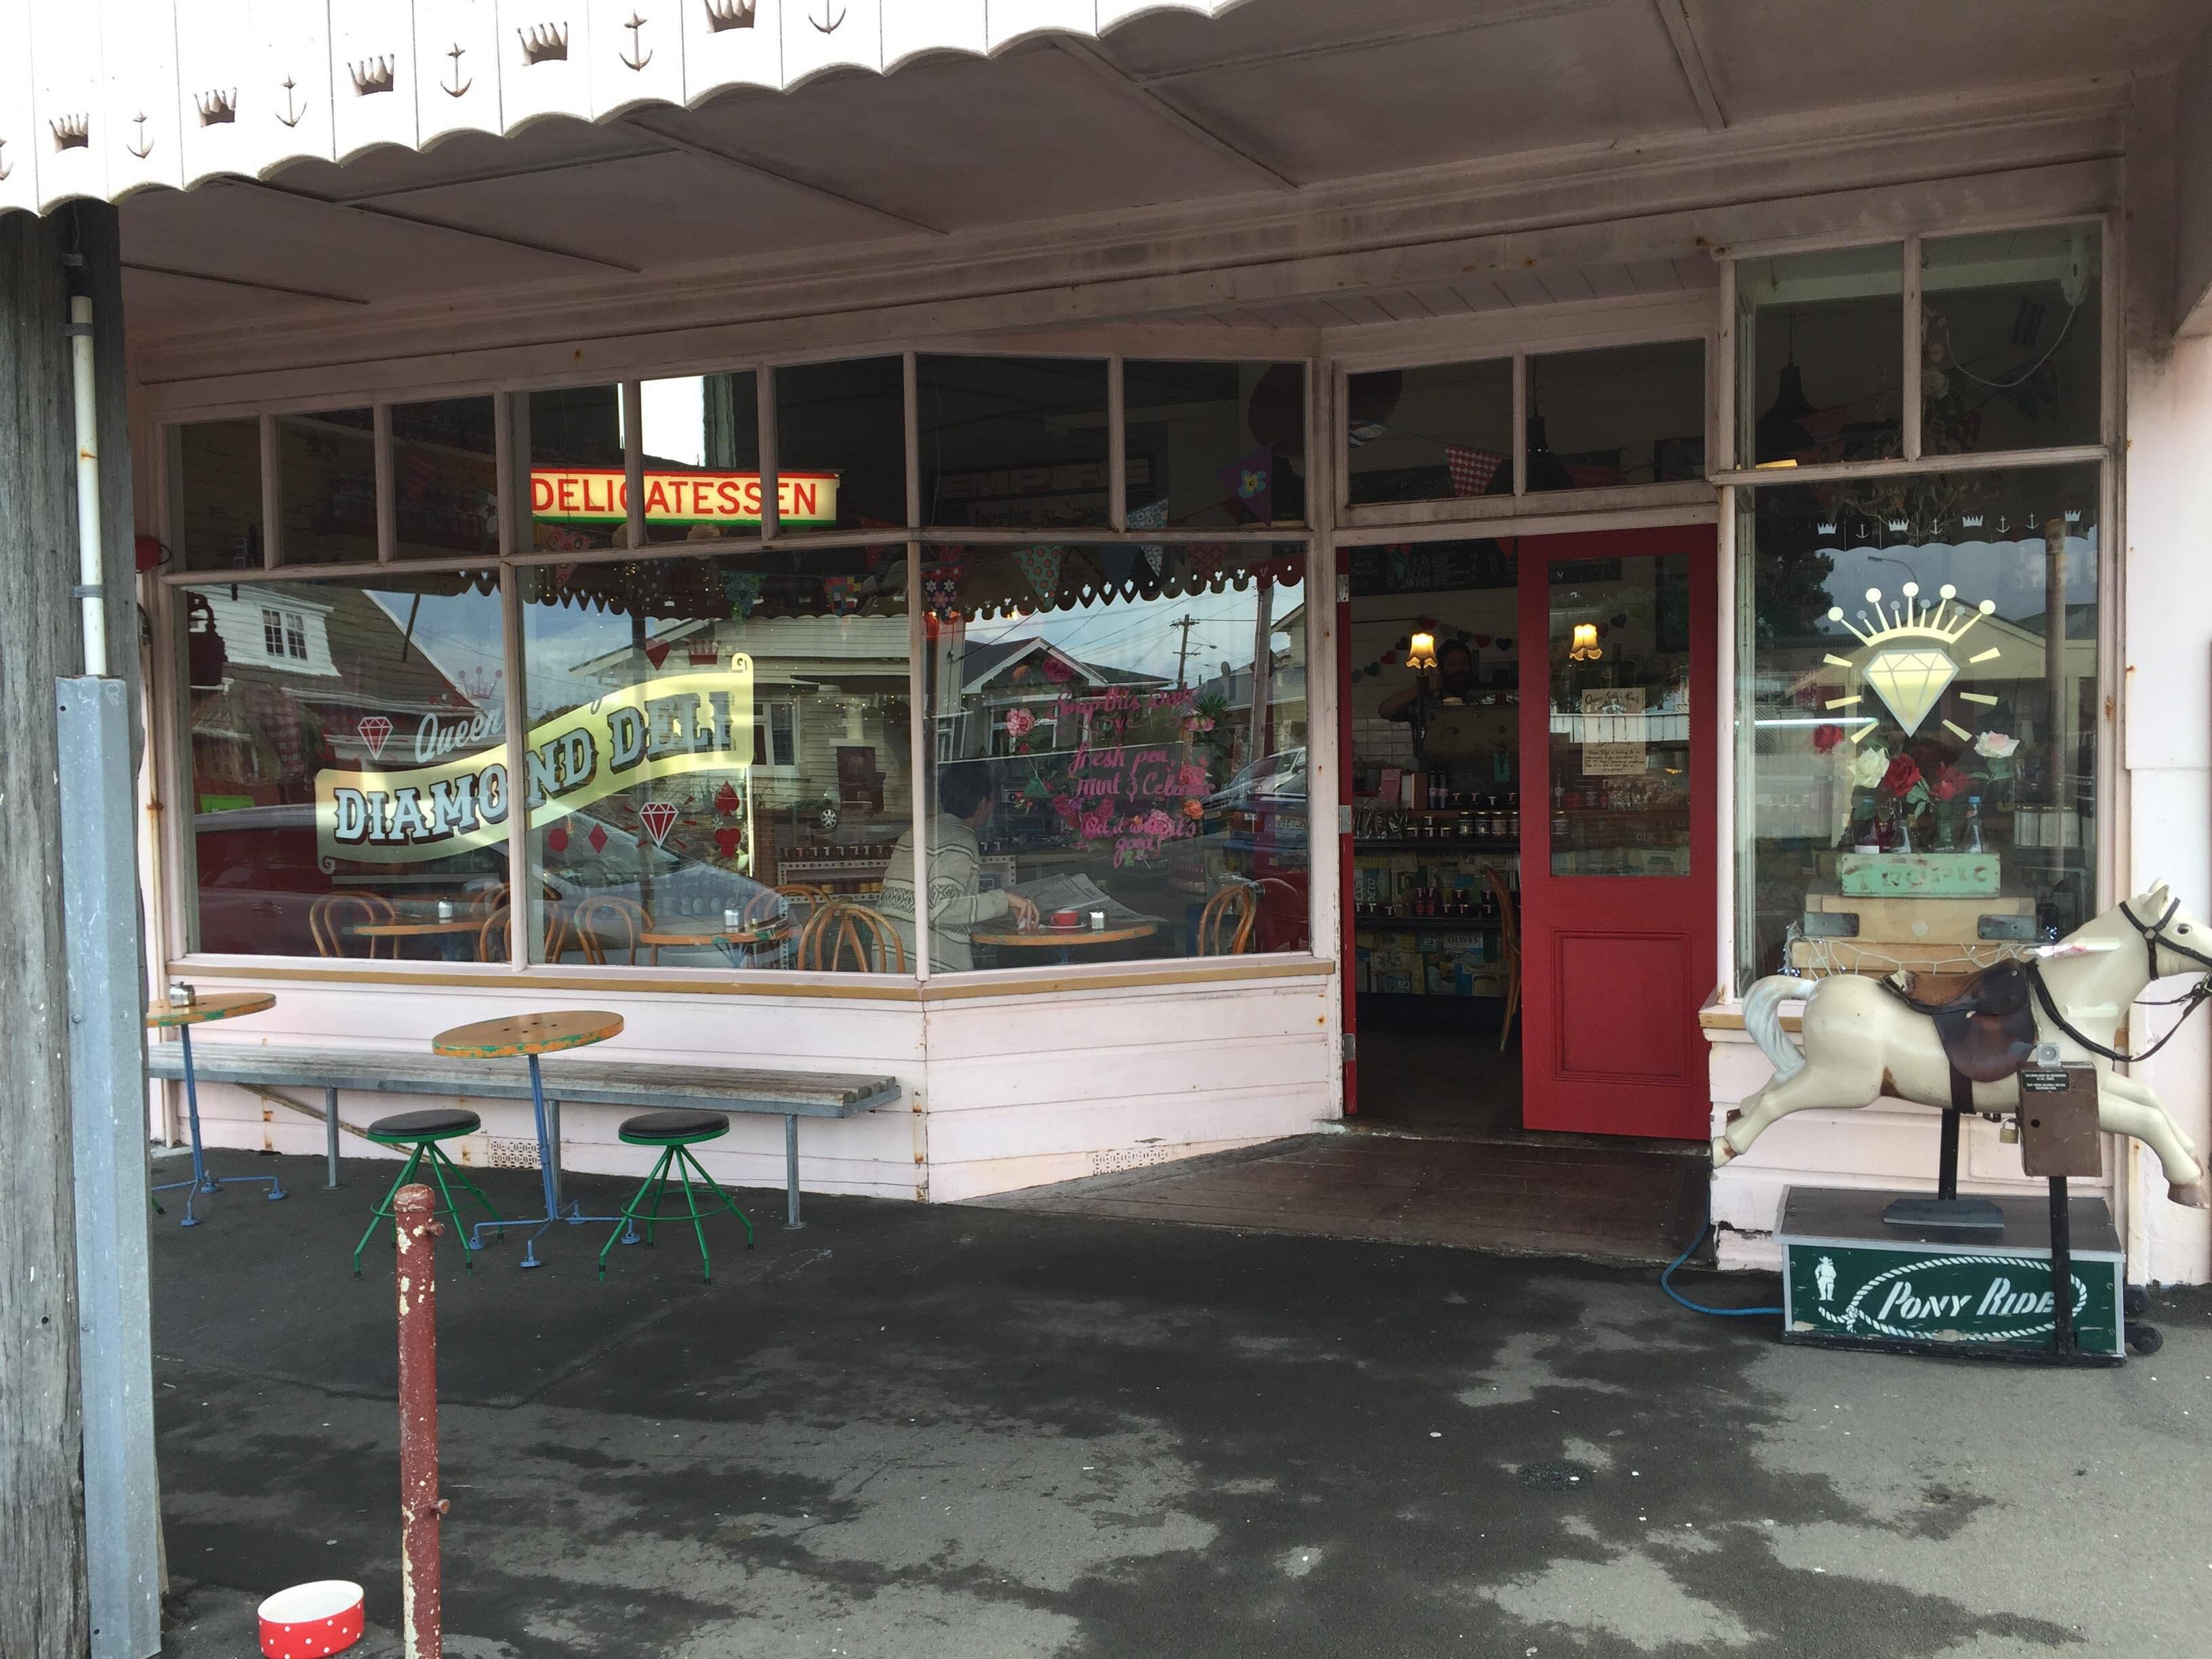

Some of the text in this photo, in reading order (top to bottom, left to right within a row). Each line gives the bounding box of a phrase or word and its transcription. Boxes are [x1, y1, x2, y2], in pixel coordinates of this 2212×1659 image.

[531, 478, 816, 515] DELIATESSEN
[1105, 686, 1143, 713] this
[415, 707, 505, 764] Queen
[333, 691, 735, 846] DIAMOND DELI
[1068, 741, 1126, 775] fresh
[1077, 772, 1121, 796] mint
